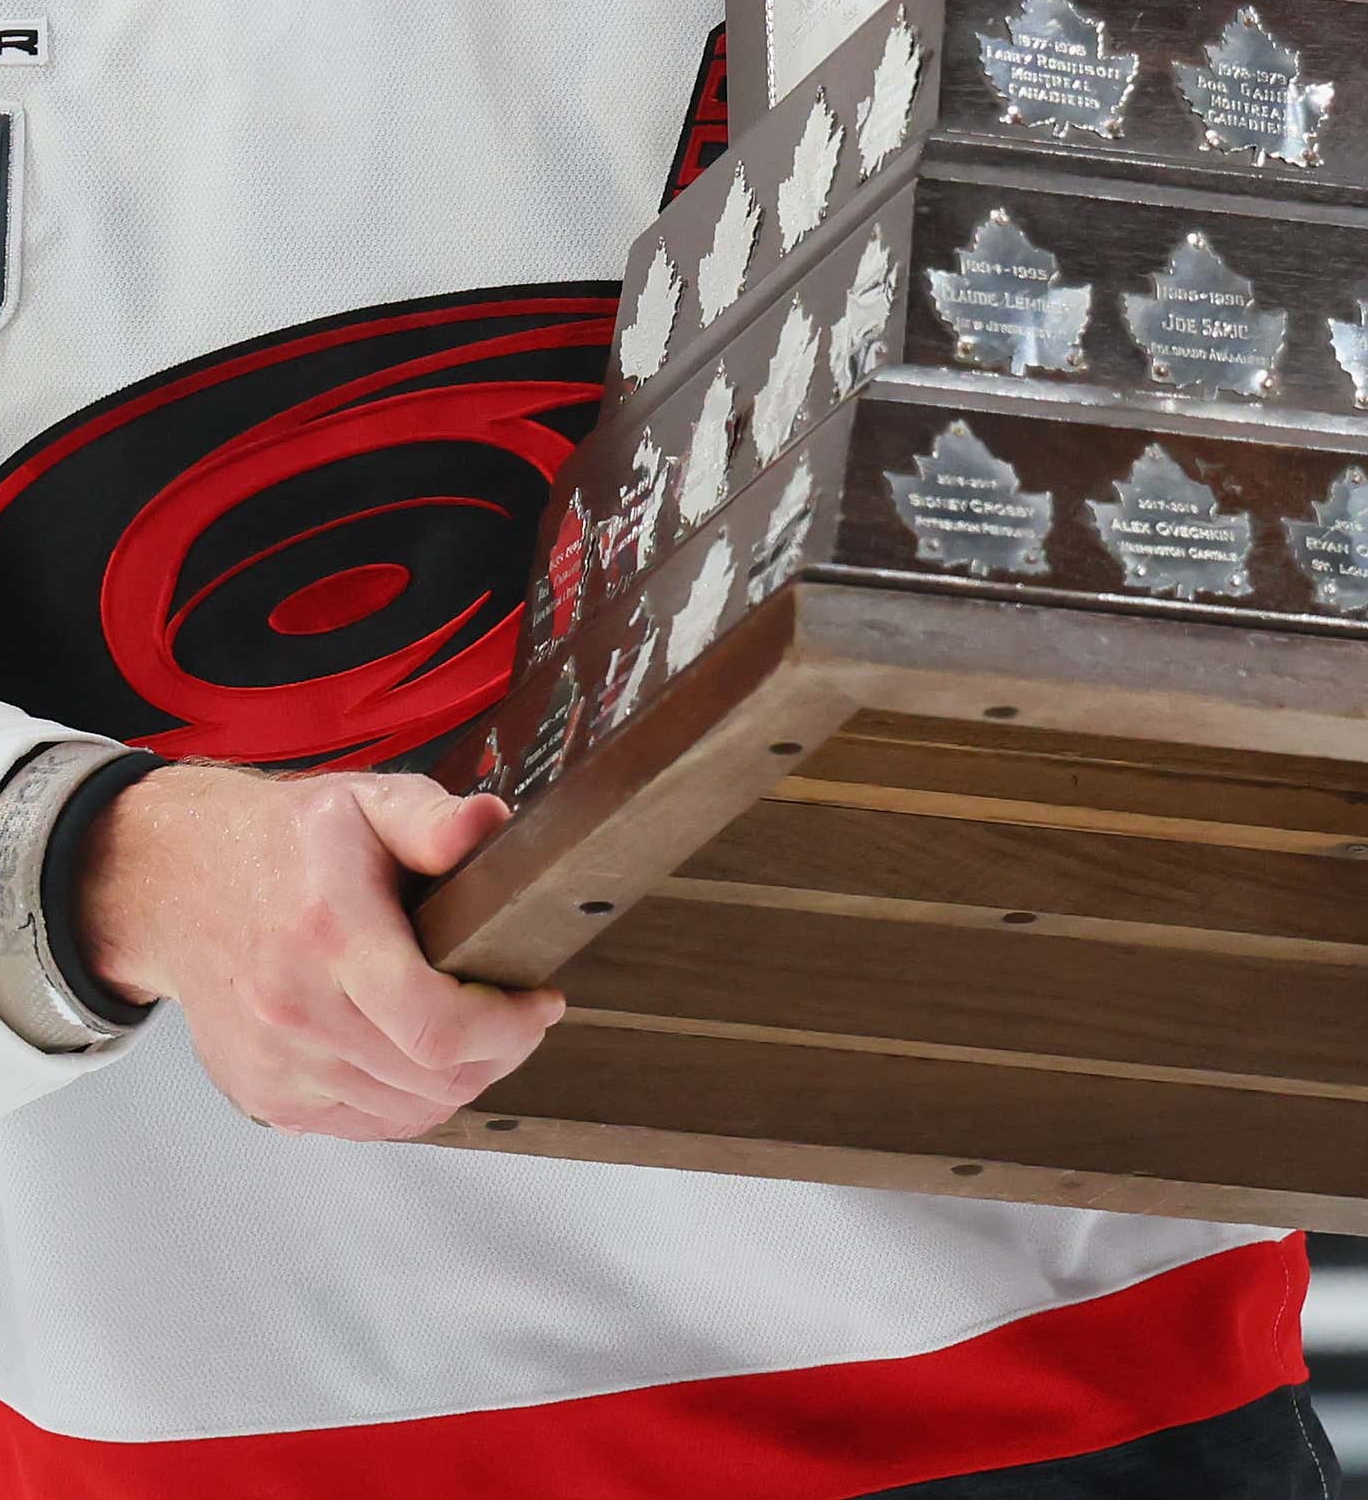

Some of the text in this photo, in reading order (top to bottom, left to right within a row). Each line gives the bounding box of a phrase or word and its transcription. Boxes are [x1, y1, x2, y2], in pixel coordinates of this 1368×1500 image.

[1036, 53, 1120, 80] ROBINSON
[1011, 67, 1092, 92] MONTREAL
[1008, 82, 1101, 109] CANADIENS
[1161, 312, 1198, 334] JOE
[908, 493, 1036, 519] SIDNEY CROSBY
[1111, 518, 1235, 542] ALEX OVECHKIN
